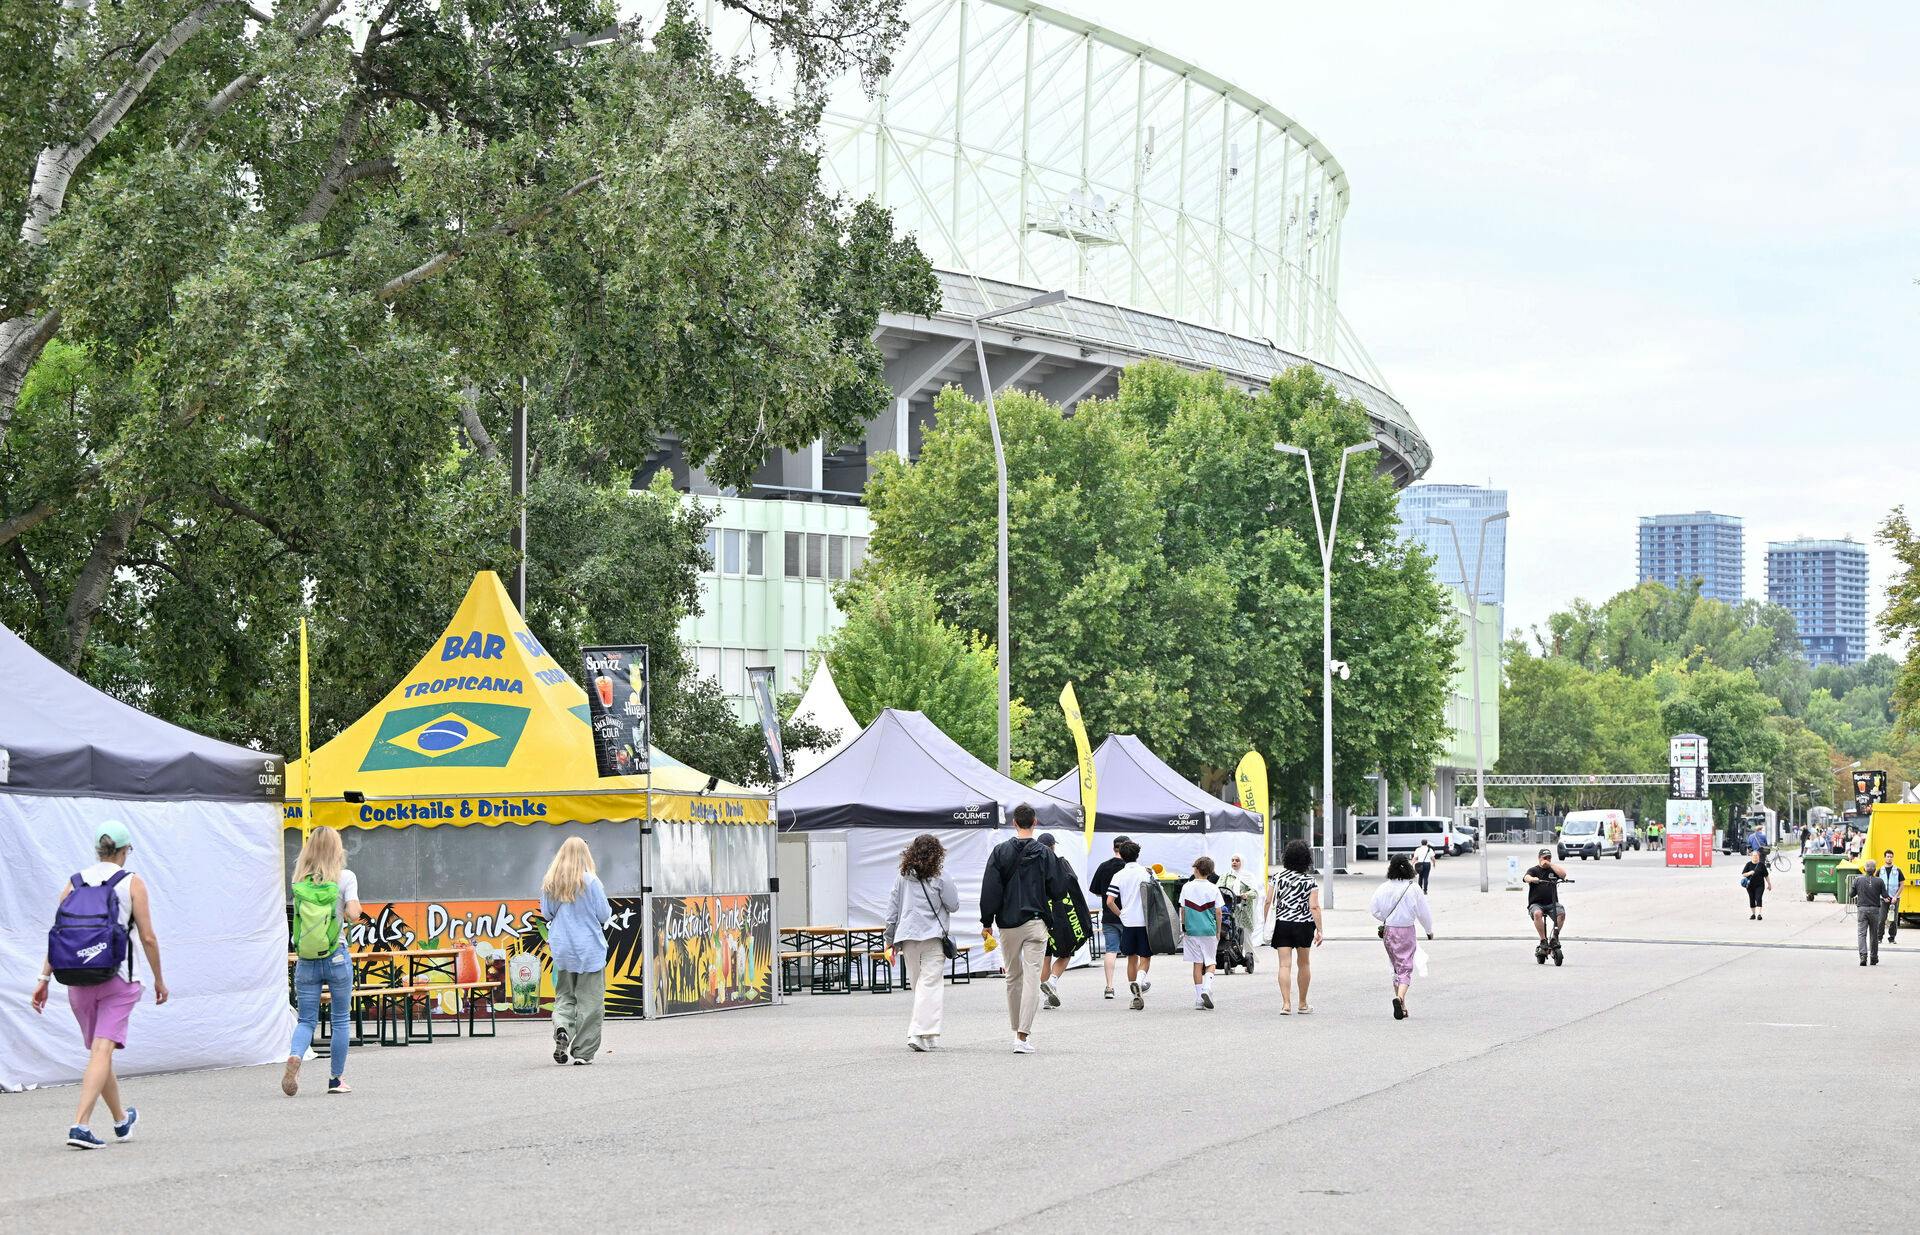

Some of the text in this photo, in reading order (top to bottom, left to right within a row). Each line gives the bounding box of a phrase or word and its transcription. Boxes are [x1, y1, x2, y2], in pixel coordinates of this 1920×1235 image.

[440, 631, 506, 662] BAR
[404, 676, 523, 698] TROPICANA
[258, 774, 282, 785] GOURMET
[360, 799, 547, 822] Cocktails & Drinks
[345, 904, 637, 948] ails, Drinks kt
[715, 898, 744, 931] Drinks
[1067, 907, 1085, 941] YONEX
[77, 942, 107, 958] speedo
